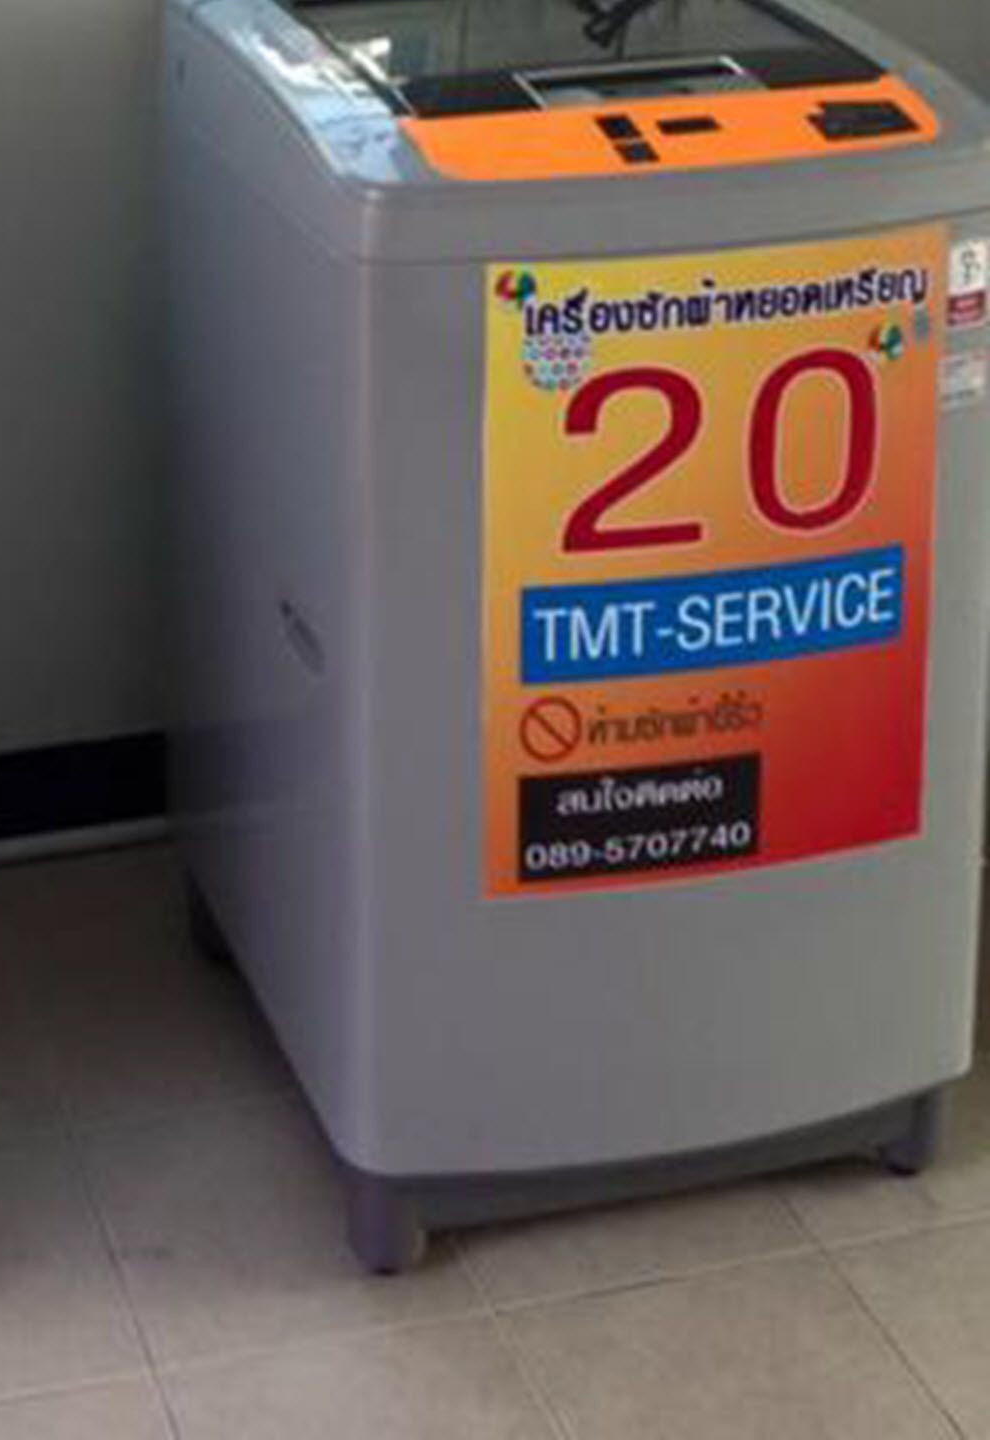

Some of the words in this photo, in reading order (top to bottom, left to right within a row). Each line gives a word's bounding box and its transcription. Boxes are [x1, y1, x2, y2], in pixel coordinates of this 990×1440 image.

[561, 346, 878, 555] 20
[533, 567, 896, 661] TMT-SERVICE
[526, 821, 751, 870] 089-5707740
